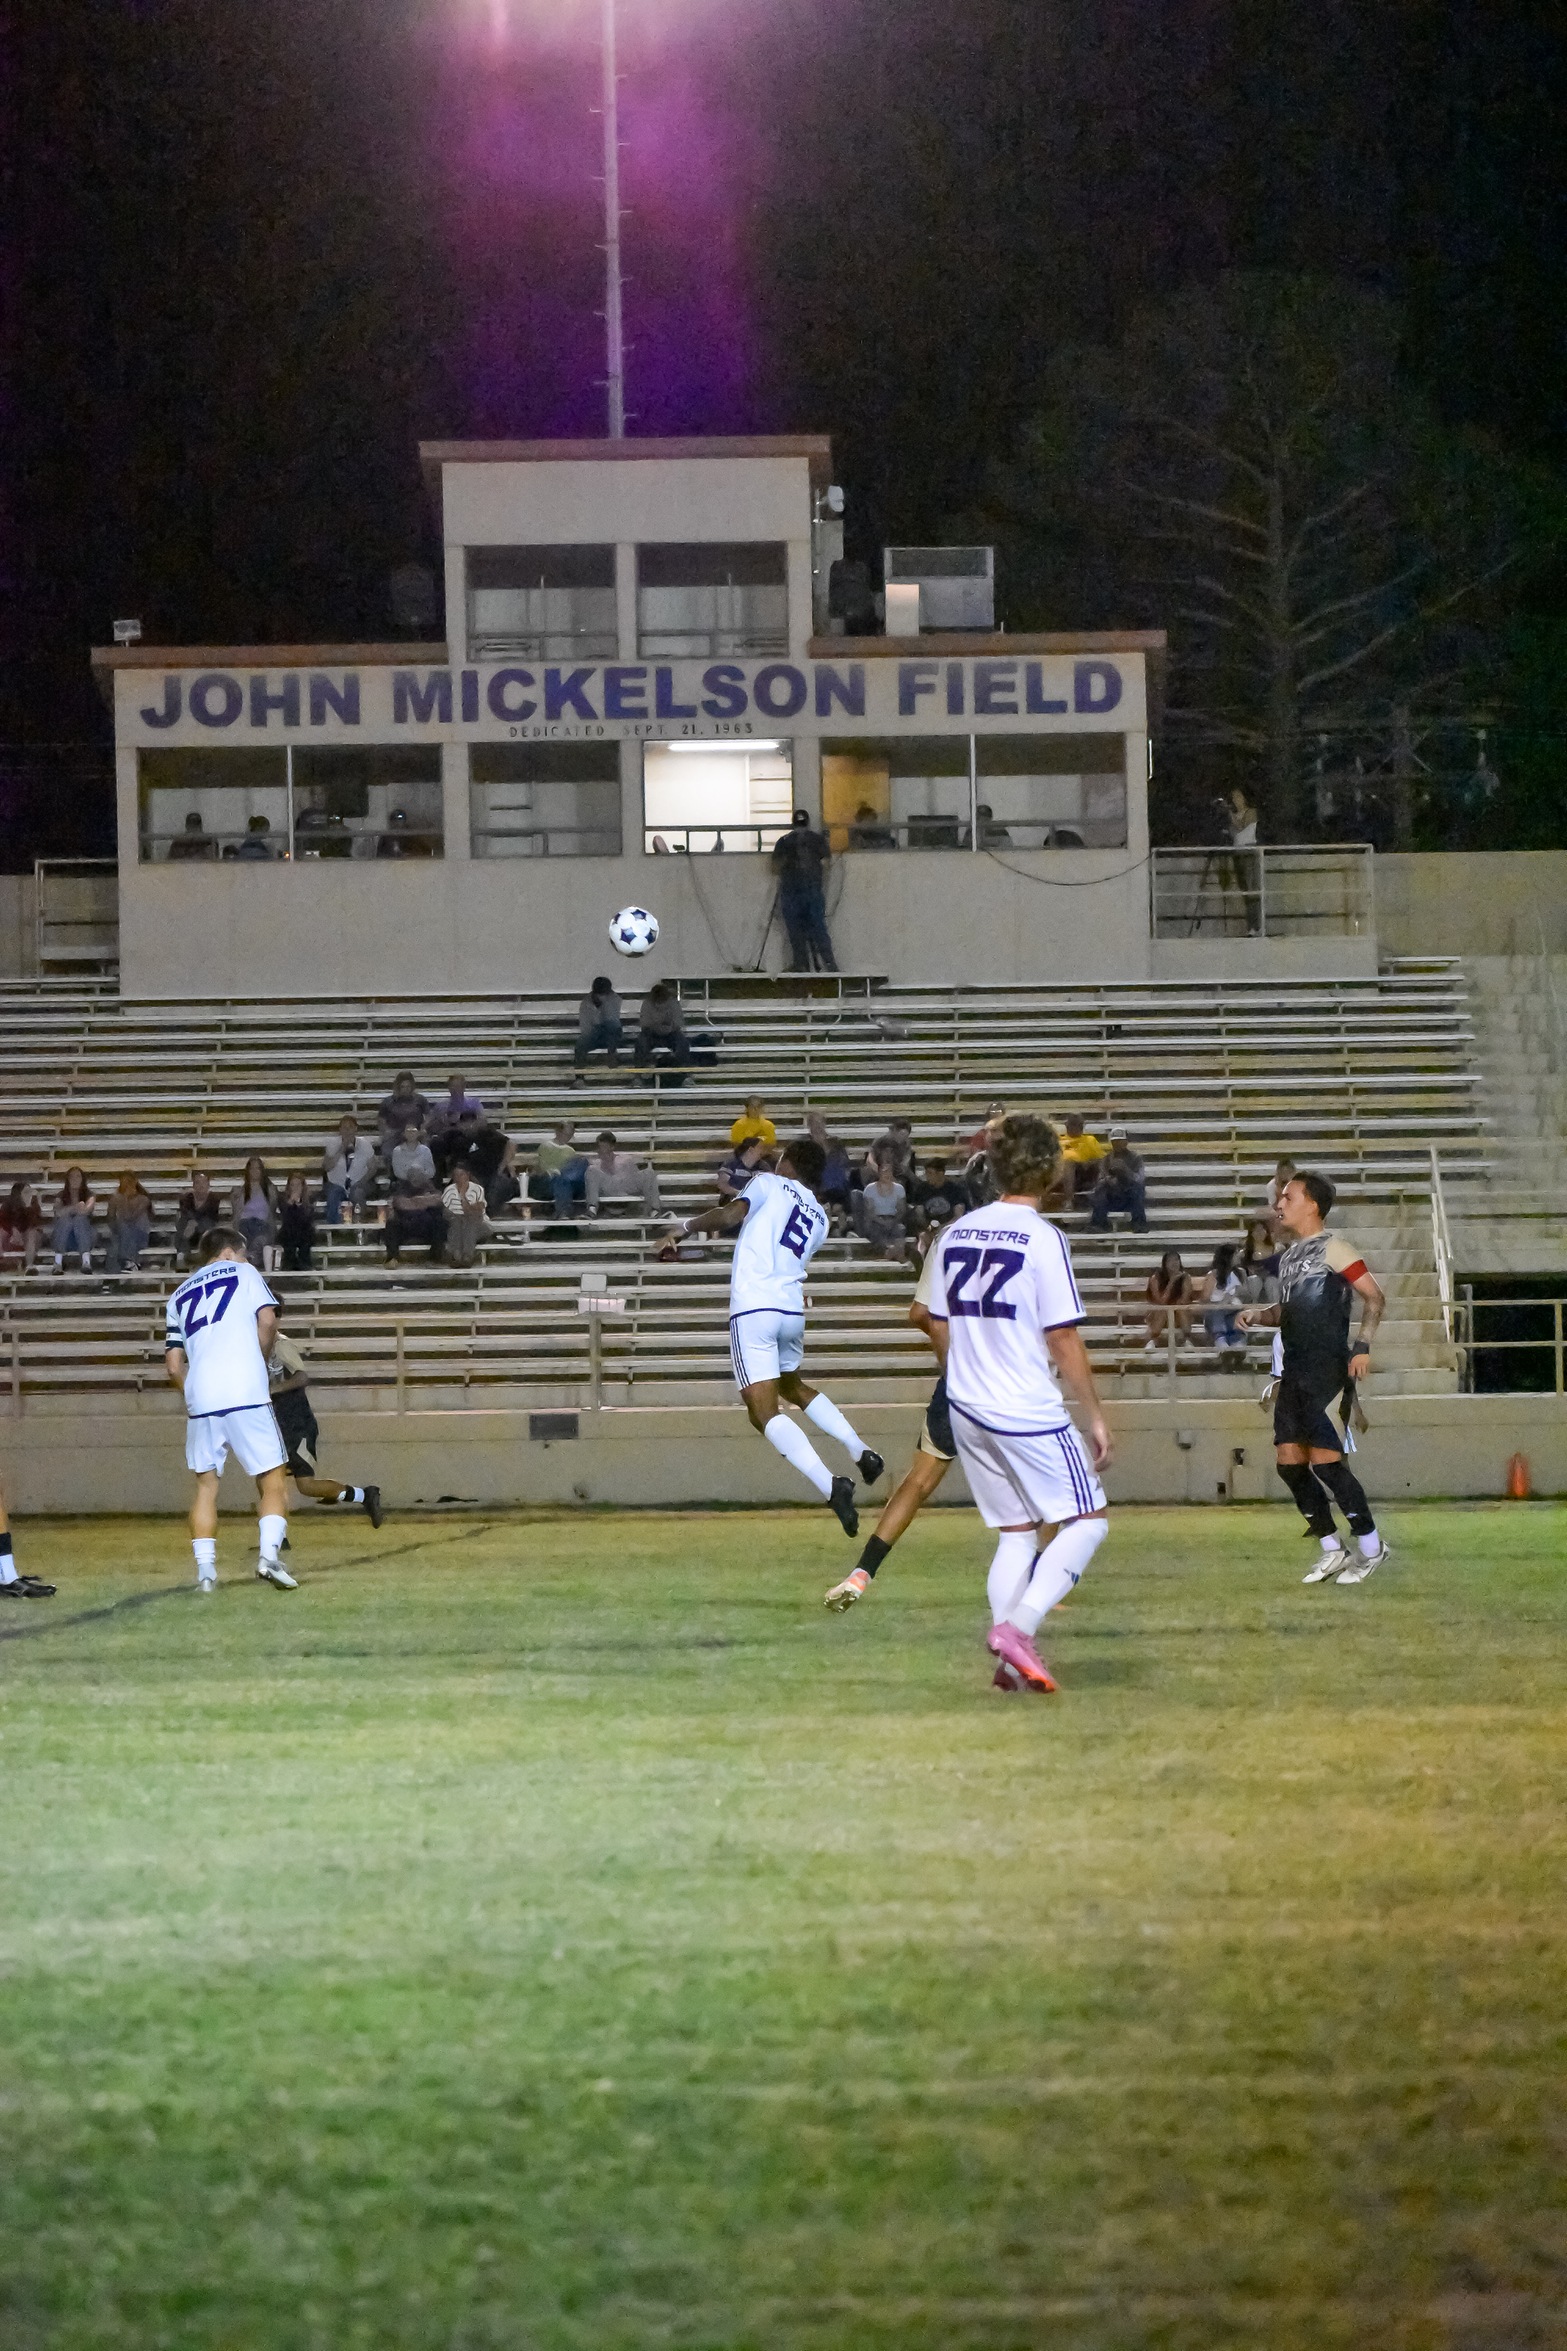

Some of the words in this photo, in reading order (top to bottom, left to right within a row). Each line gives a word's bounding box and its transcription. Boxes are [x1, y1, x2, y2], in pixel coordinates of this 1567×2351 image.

[140, 673, 360, 728] JOHN
[392, 664, 865, 724] MICKELSON
[899, 661, 1122, 717] FIELD
[509, 725, 605, 738] DEDICATED
[779, 1204, 814, 1260] 6
[951, 1229, 1031, 1245] MONSTERS
[175, 1275, 239, 1339] 27
[944, 1247, 1026, 1321] 22
